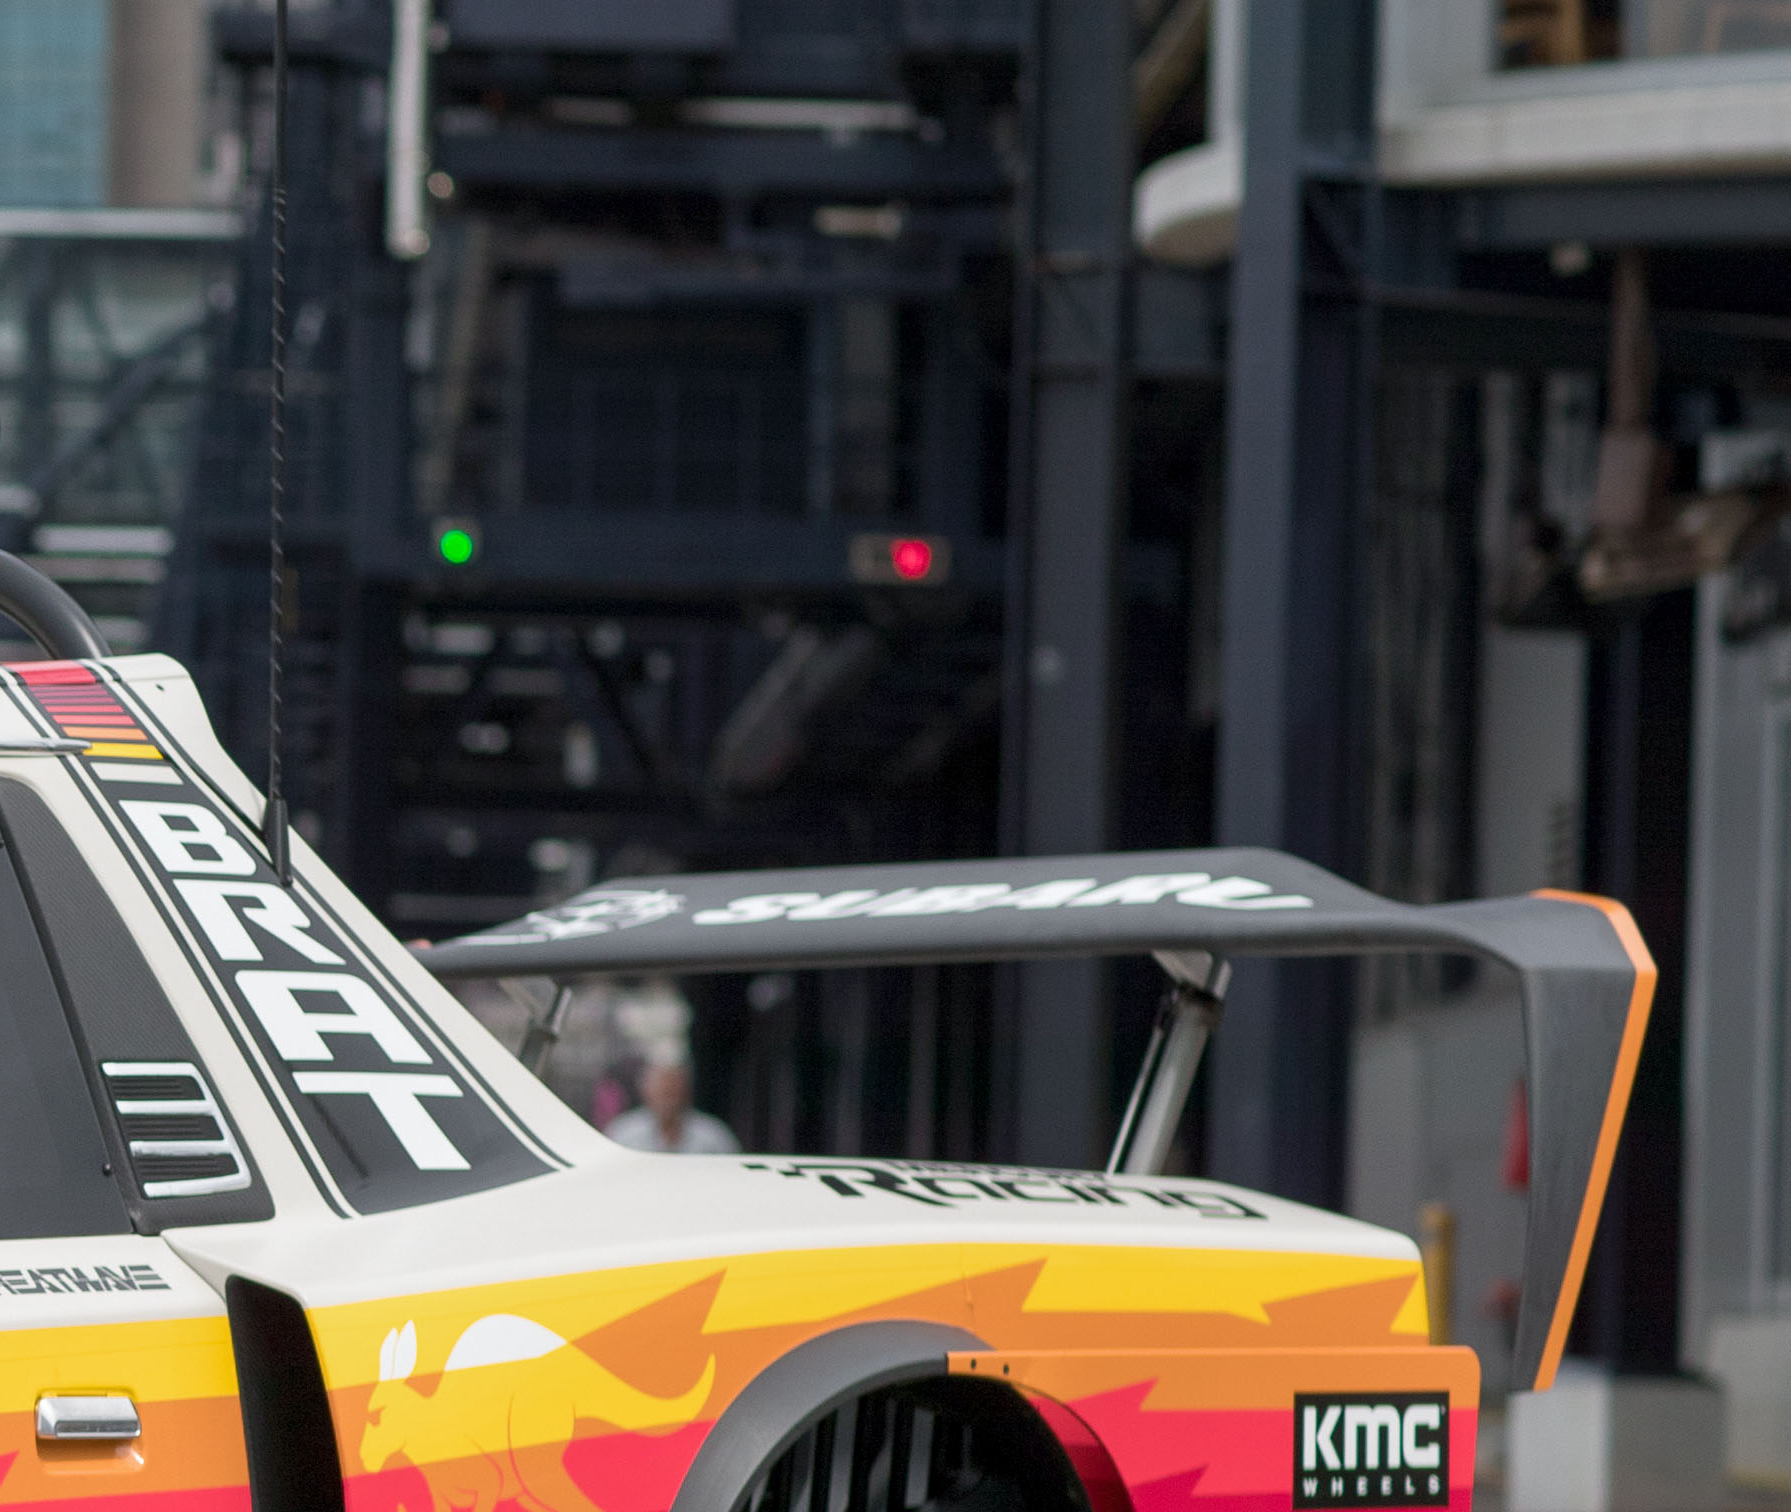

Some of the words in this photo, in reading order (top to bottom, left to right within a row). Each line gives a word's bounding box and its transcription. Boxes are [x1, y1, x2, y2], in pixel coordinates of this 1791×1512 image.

[118, 799, 472, 1171] BRAT
[1302, 1403, 1441, 1472] KMC
[1302, 1474, 1441, 1498] WHEELS
